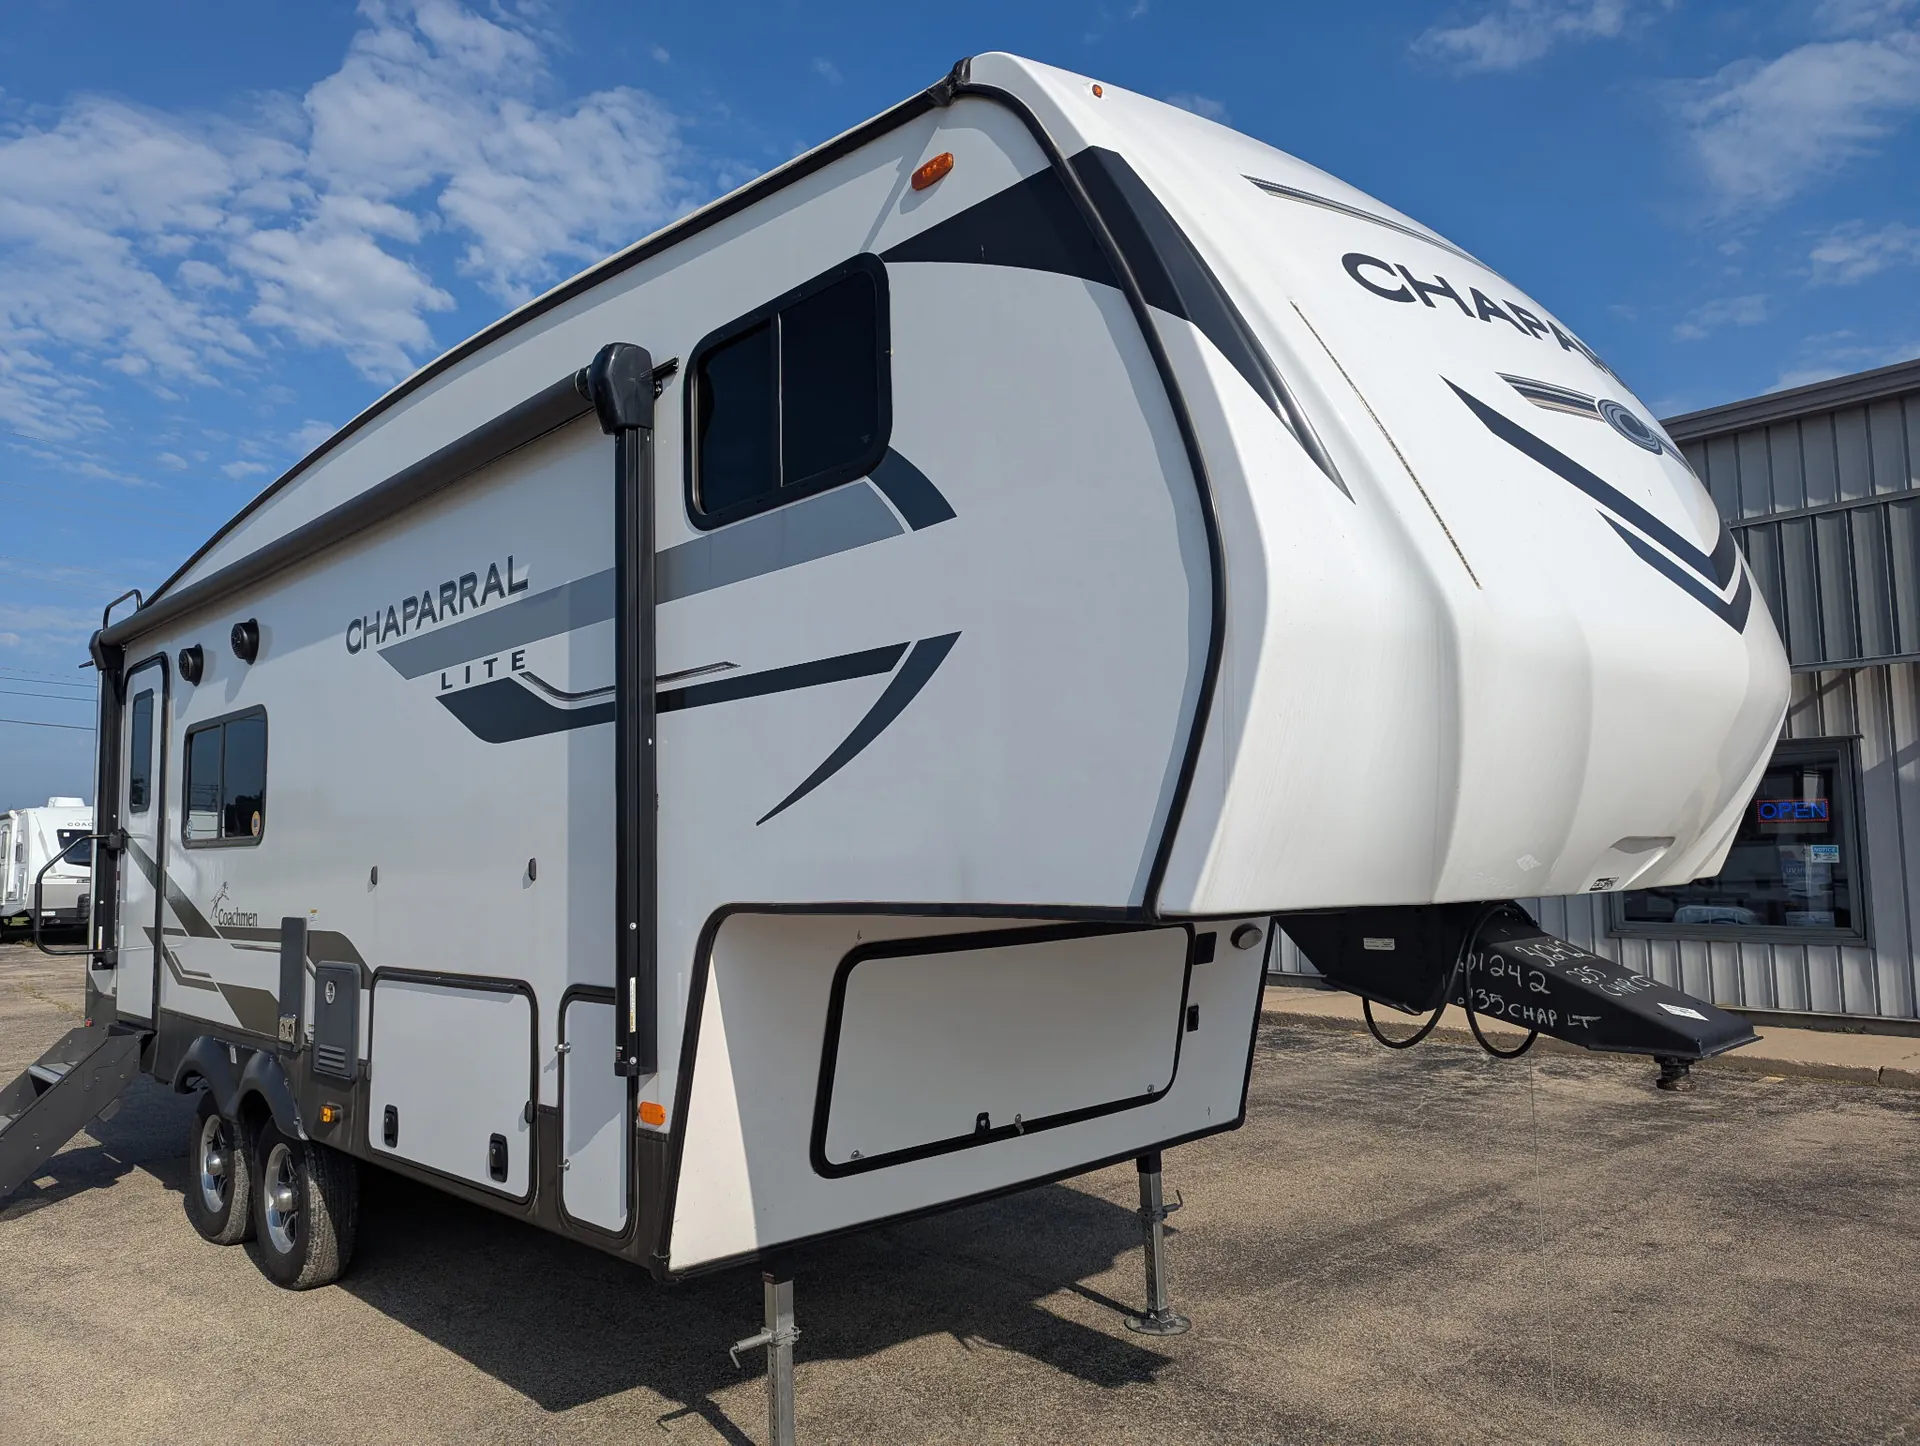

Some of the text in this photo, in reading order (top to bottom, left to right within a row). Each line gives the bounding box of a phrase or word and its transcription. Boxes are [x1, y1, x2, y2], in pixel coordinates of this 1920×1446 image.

[345, 555, 529, 655] CHAPARRAL
[440, 649, 526, 691] LITE
[1759, 801, 1827, 819] OPEN
[218, 907, 258, 927] Coachmen
[1567, 1013, 1602, 1029] LT
